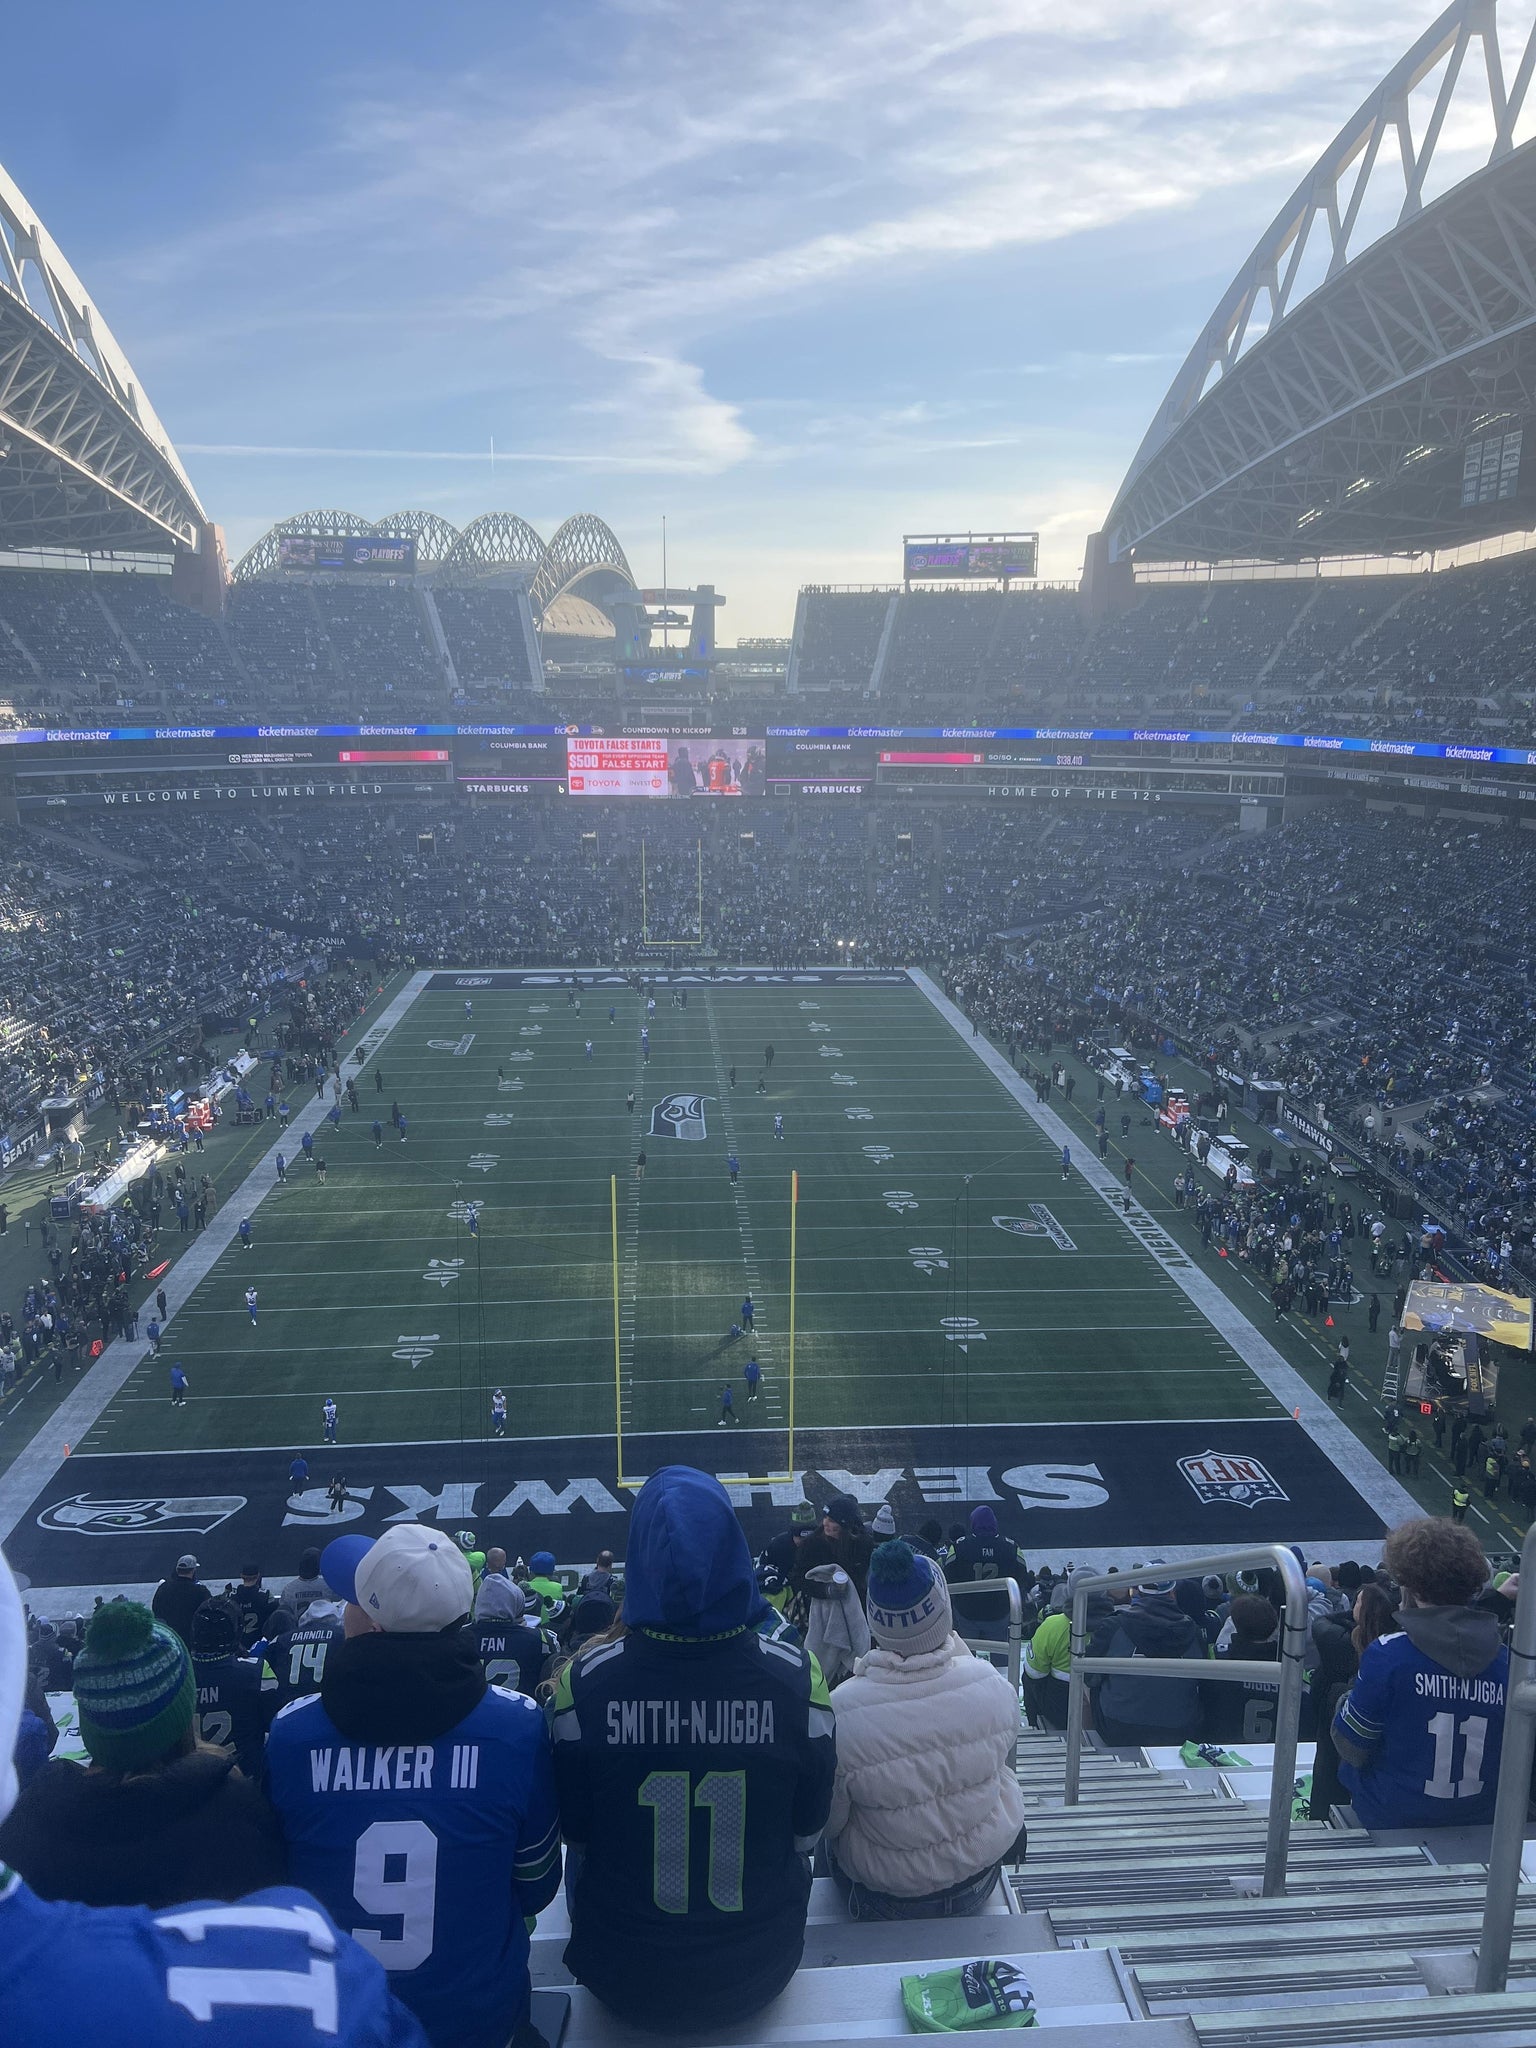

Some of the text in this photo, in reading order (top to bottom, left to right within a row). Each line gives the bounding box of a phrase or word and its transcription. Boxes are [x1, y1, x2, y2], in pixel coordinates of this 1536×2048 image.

[371, 548, 405, 560] PLAYOFFS
[47, 730, 111, 741] ticketmaster
[155, 728, 216, 738] ticketmaster
[258, 726, 319, 737] ticketmaster
[360, 725, 417, 736] ticketmaster
[457, 725, 515, 735] ticketmaster
[848, 728, 904, 738] ticketmaster
[942, 728, 997, 739] ticketmaster
[1036, 729, 1093, 740] ticketmaster
[1133, 731, 1190, 741] ticketmaster
[574, 740, 662, 750] TOYOTA FALSE STARTS
[1231, 732, 1278, 744] ticketmaster
[1304, 736, 1343, 749] ticketmaster
[1370, 740, 1416, 755] ticketmaster
[1445, 747, 1494, 761] ticketmaster
[569, 753, 599, 768] $500
[602, 760, 665, 768] FALSE START
[104, 785, 382, 804] WELCOME TO LUMEN FIELD
[466, 784, 529, 793] STARBUCKS
[802, 785, 862, 794] STARBUCKS
[988, 787, 1161, 802] HOME OF THE 12s
[521, 975, 823, 984] SEAHAWKS
[882, 1191, 920, 1208] 30
[1122, 1211, 1193, 1269] AMERICA
[907, 1247, 949, 1270] 20
[422, 1258, 465, 1281] 20
[939, 1316, 987, 1341] 10
[391, 1333, 440, 1360] 10
[326, 1410, 335, 1419] 15
[1188, 1458, 1263, 1484] NFL
[281, 1463, 1109, 1527] SEAHWKS
[982, 1547, 994, 1557] FAN
[972, 1562, 999, 1581] 12
[291, 1630, 333, 1642] DARNOLD
[480, 1637, 506, 1652] FAN
[289, 1643, 328, 1685] 14
[1415, 1672, 1504, 1706] SMITH-NJIGBA
[606, 1700, 775, 1745] SMITH-NJIGBA
[1243, 1699, 1274, 1743] 6
[1424, 1711, 1489, 1799] 11
[310, 1745, 479, 1792] WALKER III
[638, 1769, 746, 1914] 11
[352, 1820, 438, 1971] 9
[153, 1905, 338, 2035] 11
